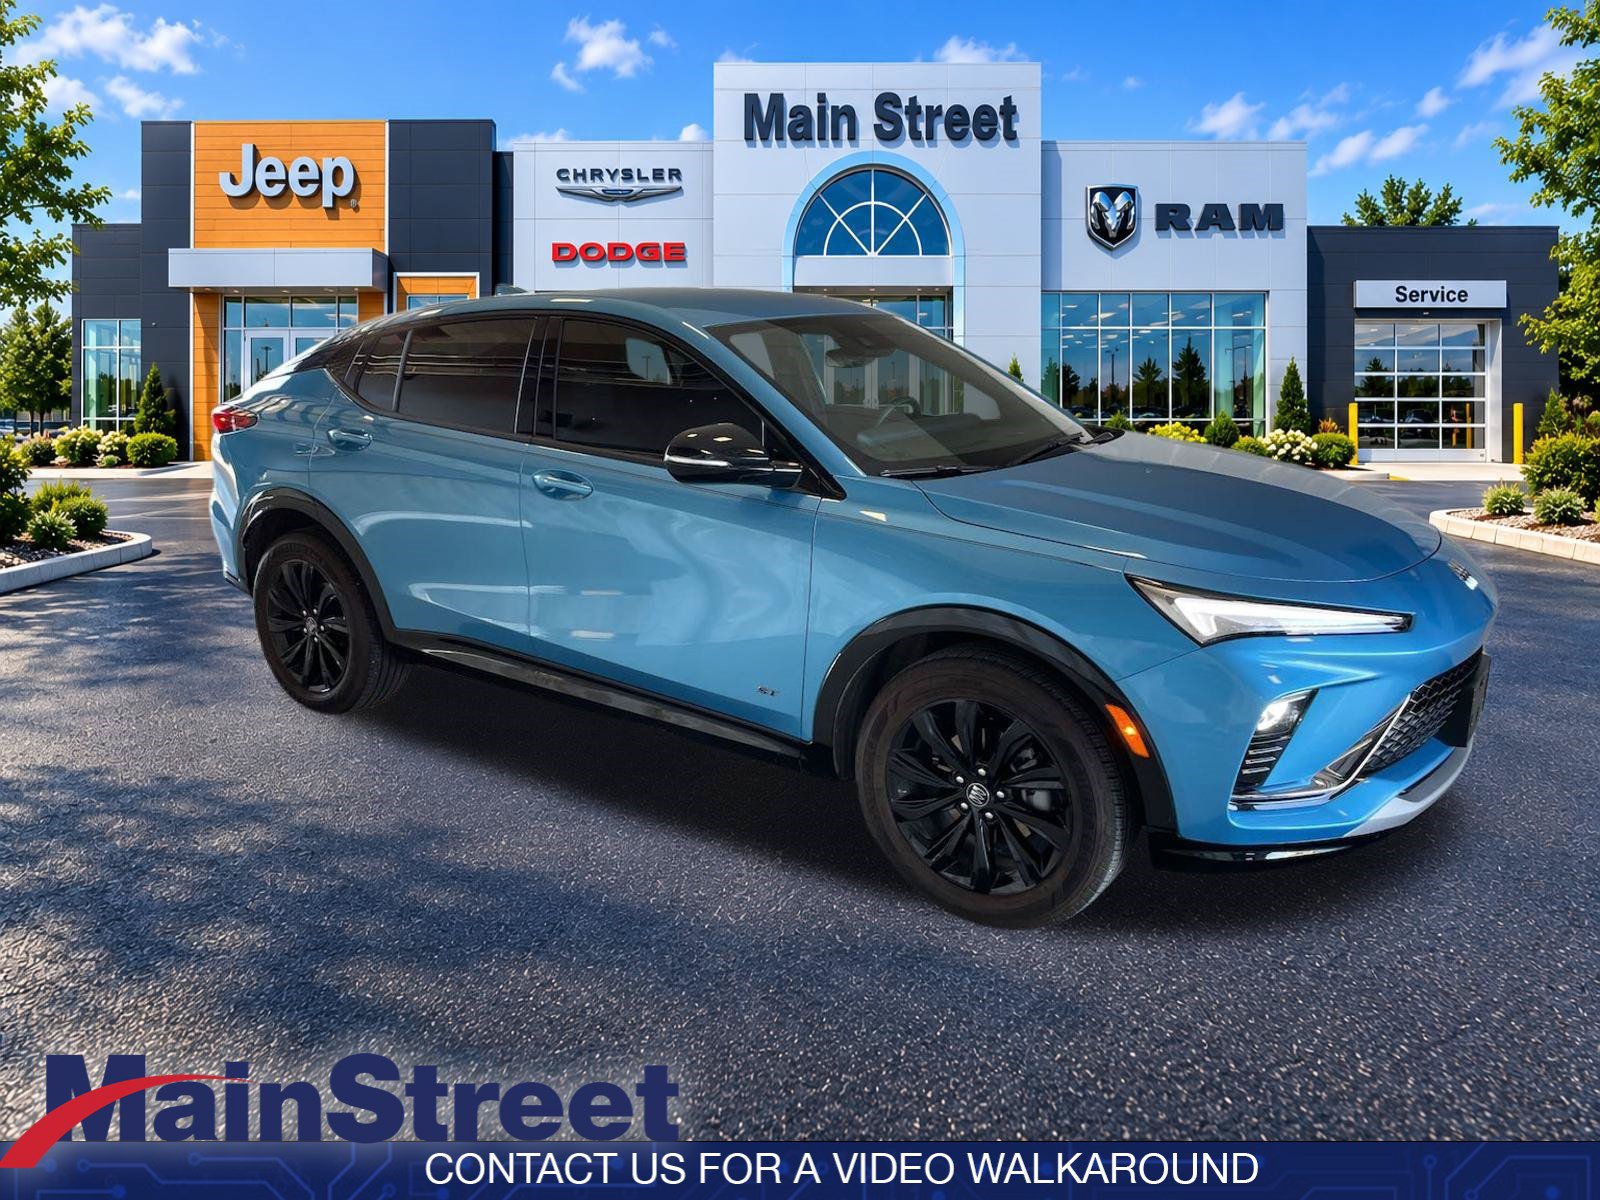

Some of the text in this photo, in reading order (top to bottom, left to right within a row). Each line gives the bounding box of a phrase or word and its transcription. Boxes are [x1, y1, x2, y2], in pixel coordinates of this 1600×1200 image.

[744, 91, 1017, 141] Main Street
[219, 143, 355, 209] Jeep
[556, 168, 682, 182] CHRYSLER
[1155, 203, 1284, 231] RAM
[551, 241, 686, 261] DODGE
[1395, 285, 1469, 303] Service
